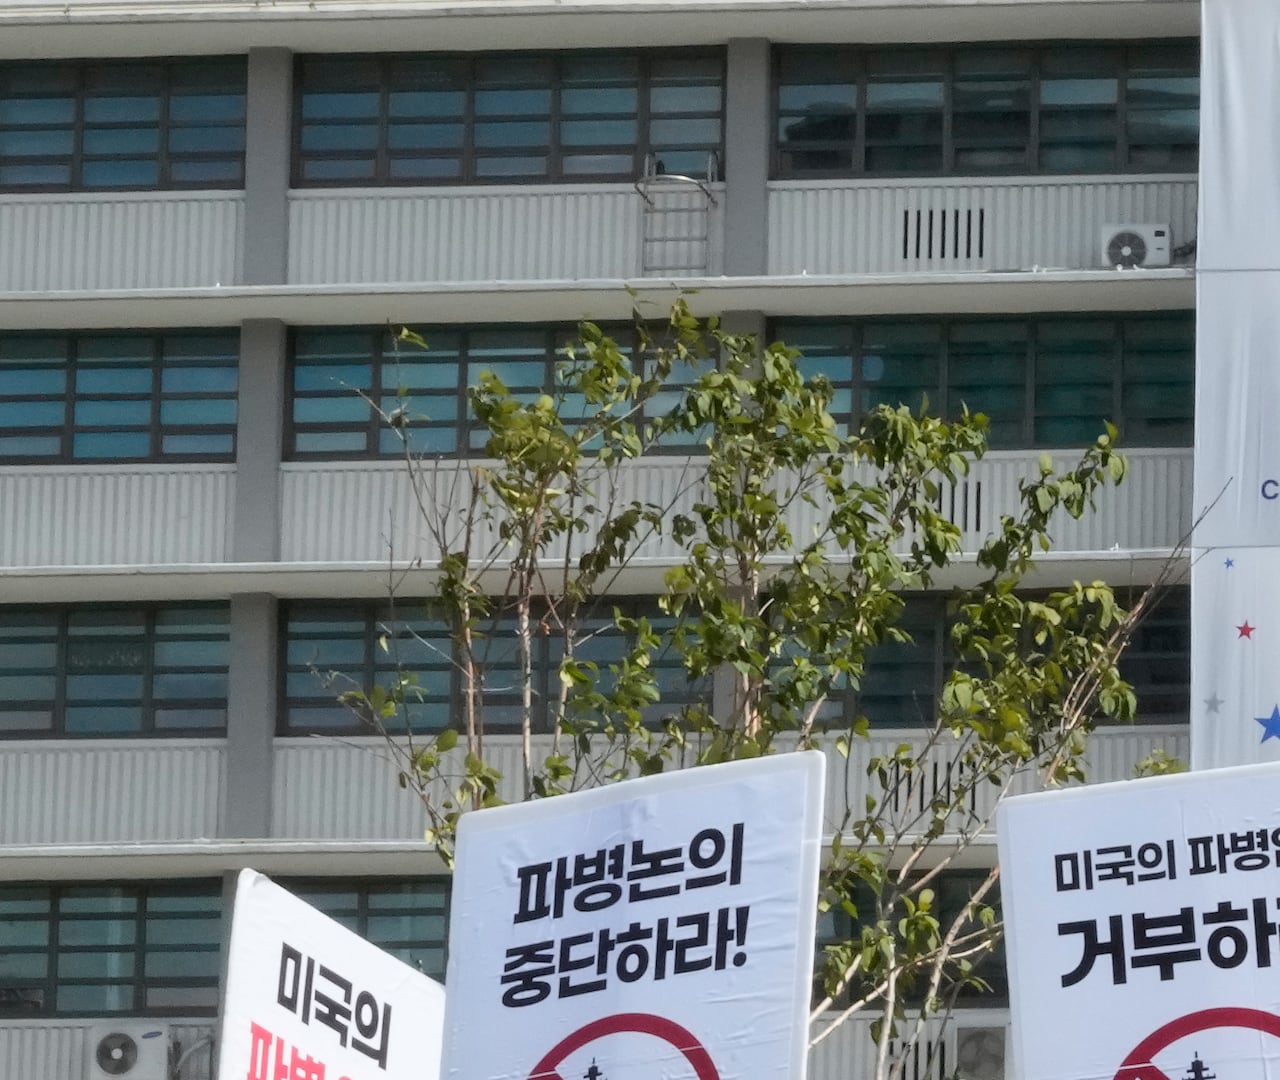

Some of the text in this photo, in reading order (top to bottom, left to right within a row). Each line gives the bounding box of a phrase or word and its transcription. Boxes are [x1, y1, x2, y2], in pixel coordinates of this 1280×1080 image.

[513, 822, 746, 926] 파병논의
[1054, 839, 1177, 892] 미국의
[277, 942, 393, 1070] 미국의
[500, 905, 751, 1009] 중단하라!
